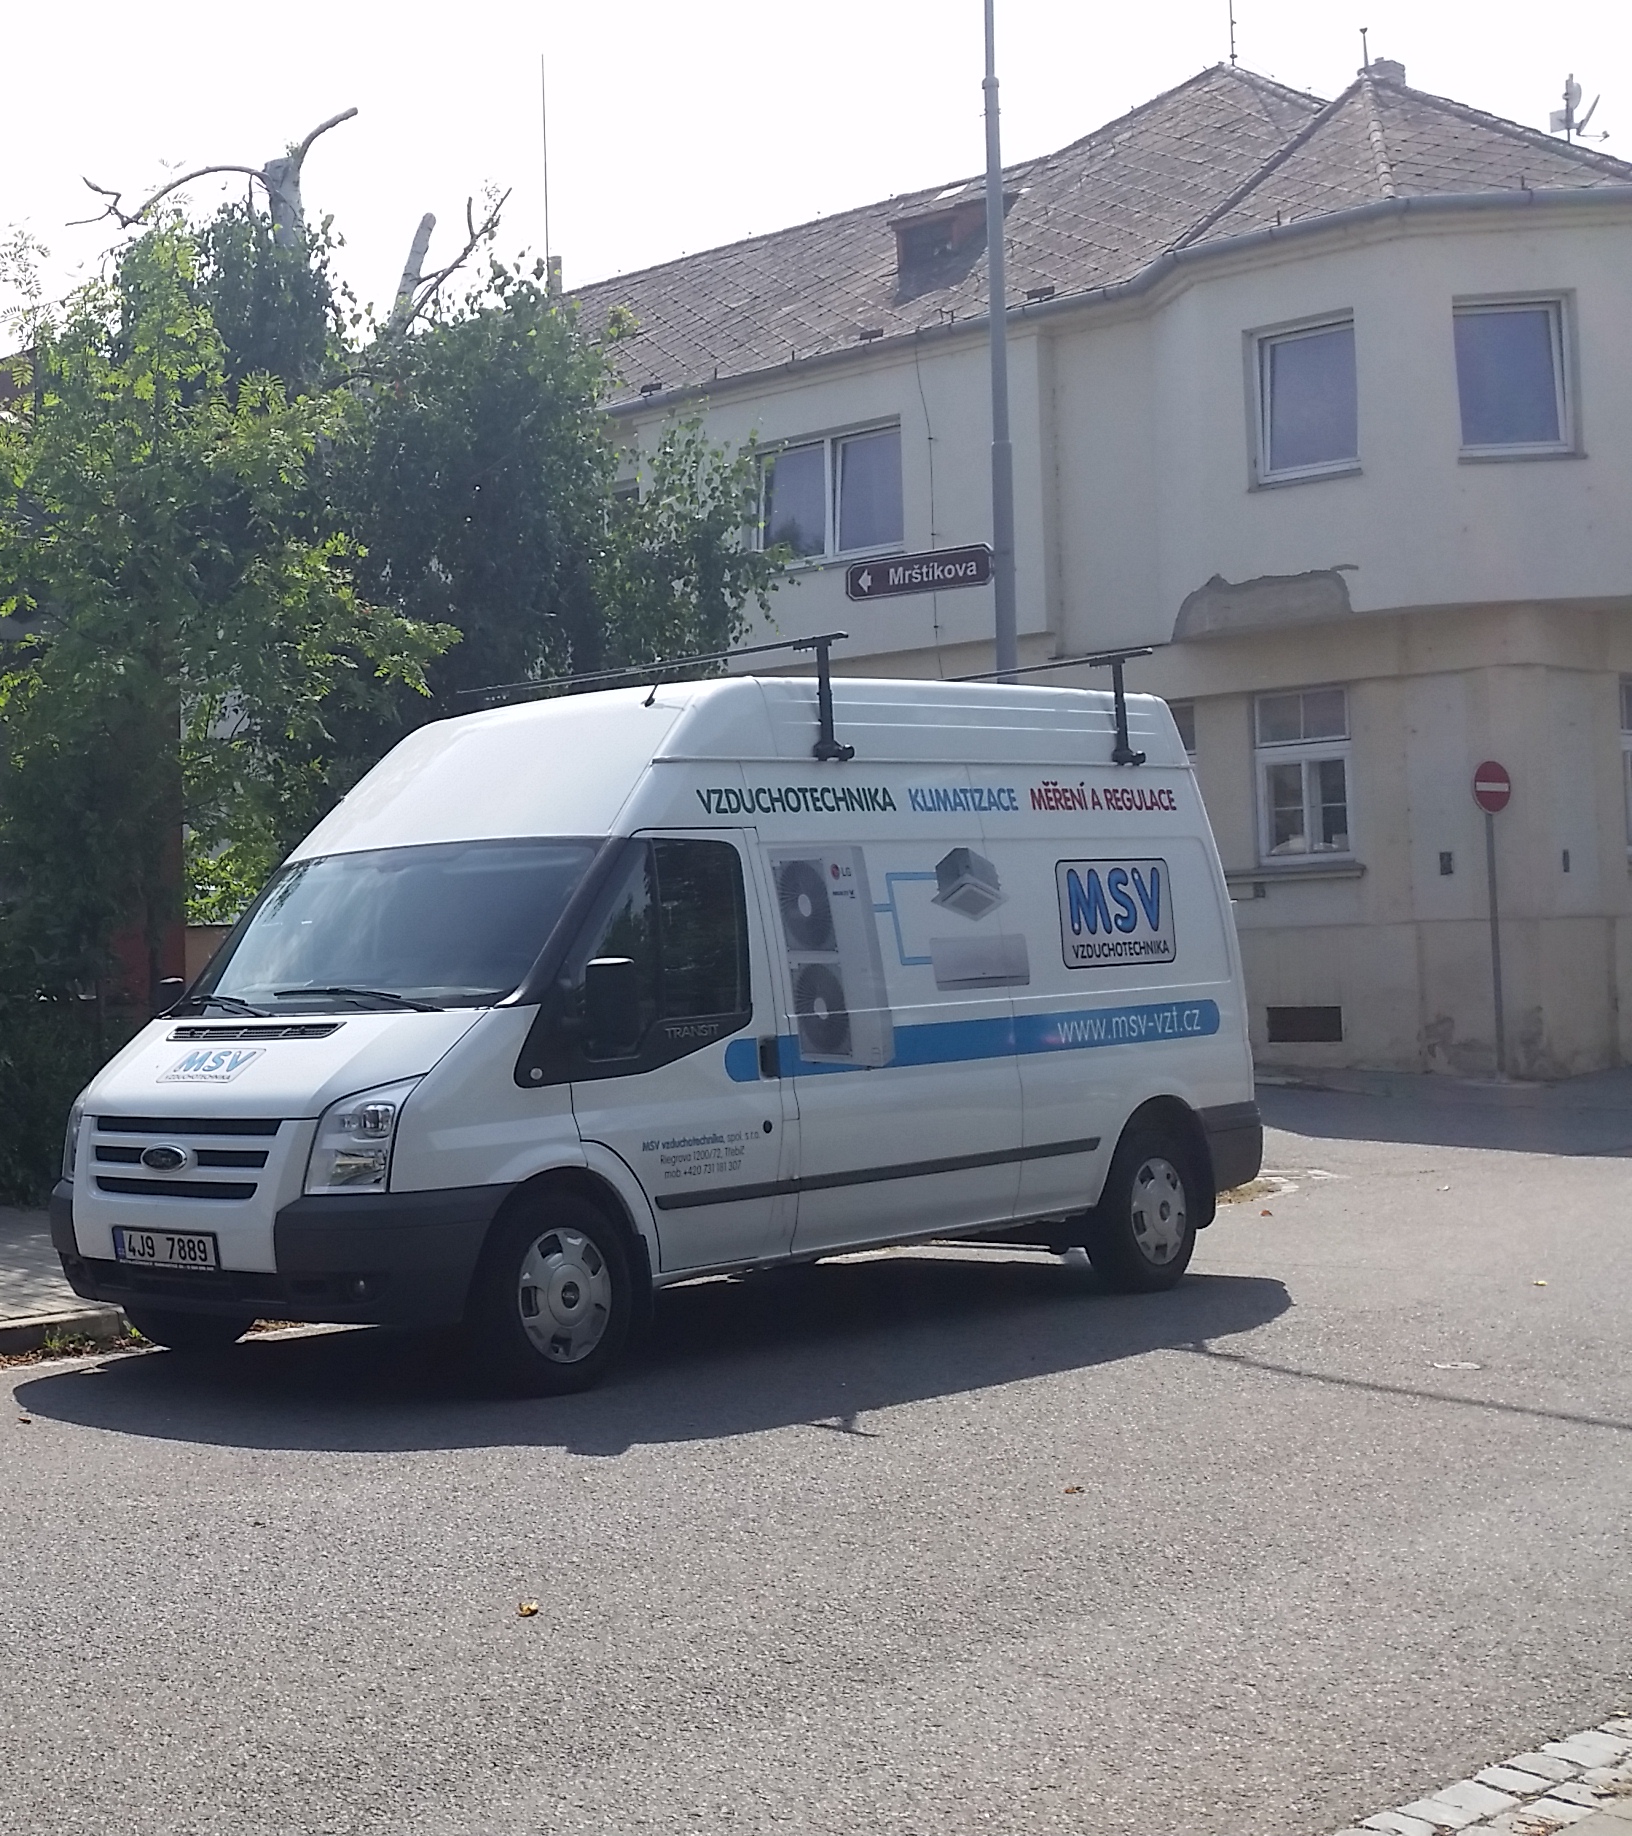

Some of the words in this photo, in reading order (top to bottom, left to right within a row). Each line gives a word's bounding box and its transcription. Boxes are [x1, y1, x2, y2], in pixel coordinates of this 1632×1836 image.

[888, 561, 977, 586] Mrštíkova
[695, 787, 897, 815] VZDUCHOTECHNIKA
[908, 788, 1019, 812] KLIMATIZACE
[1029, 780, 1089, 811] MĚŘENÍ
[1090, 788, 1103, 811] A
[1103, 788, 1177, 811] REGULACE
[841, 866, 852, 877] LG
[1066, 866, 1161, 936] MSV
[1071, 940, 1170, 959] VZDUCHOTECHNIKA
[664, 1024, 719, 1039] TRANSIT
[1057, 1006, 1202, 1044] www.msv-vzt.cz
[173, 1050, 257, 1073] MSV
[642, 1140, 660, 1152] MSV
[683, 1165, 702, 1176] +420
[128, 1234, 155, 1258] 4J9
[165, 1237, 208, 1262] 7889
